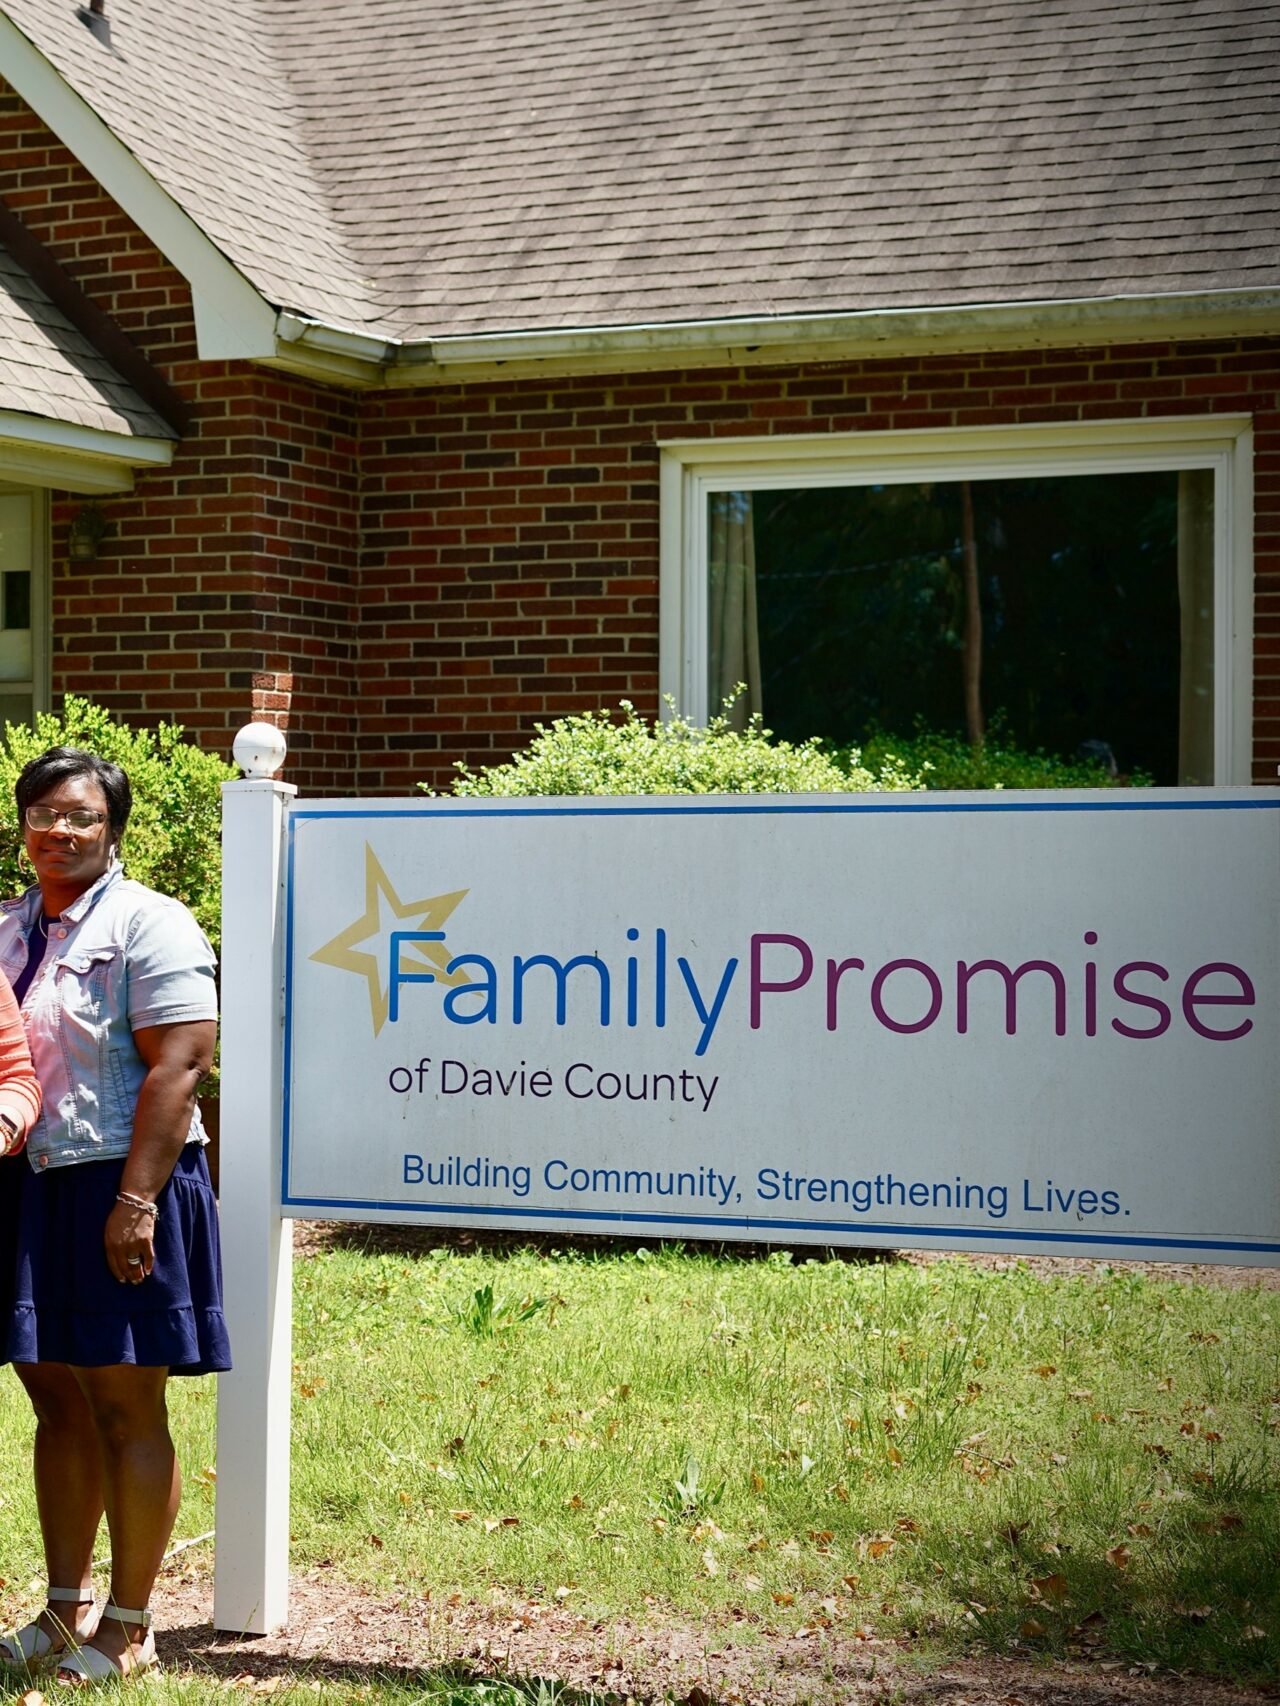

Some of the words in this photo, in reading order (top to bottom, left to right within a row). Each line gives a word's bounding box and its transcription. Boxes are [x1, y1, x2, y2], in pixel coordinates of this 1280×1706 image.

[388, 1058, 431, 1094] of
[441, 1060, 553, 1097] Davie
[565, 1063, 719, 1113] County
[403, 1154, 531, 1196] Building
[544, 1159, 743, 1206] Community,
[756, 1168, 1008, 1218] Strengthening
[1023, 1179, 1131, 1216] Lives.
